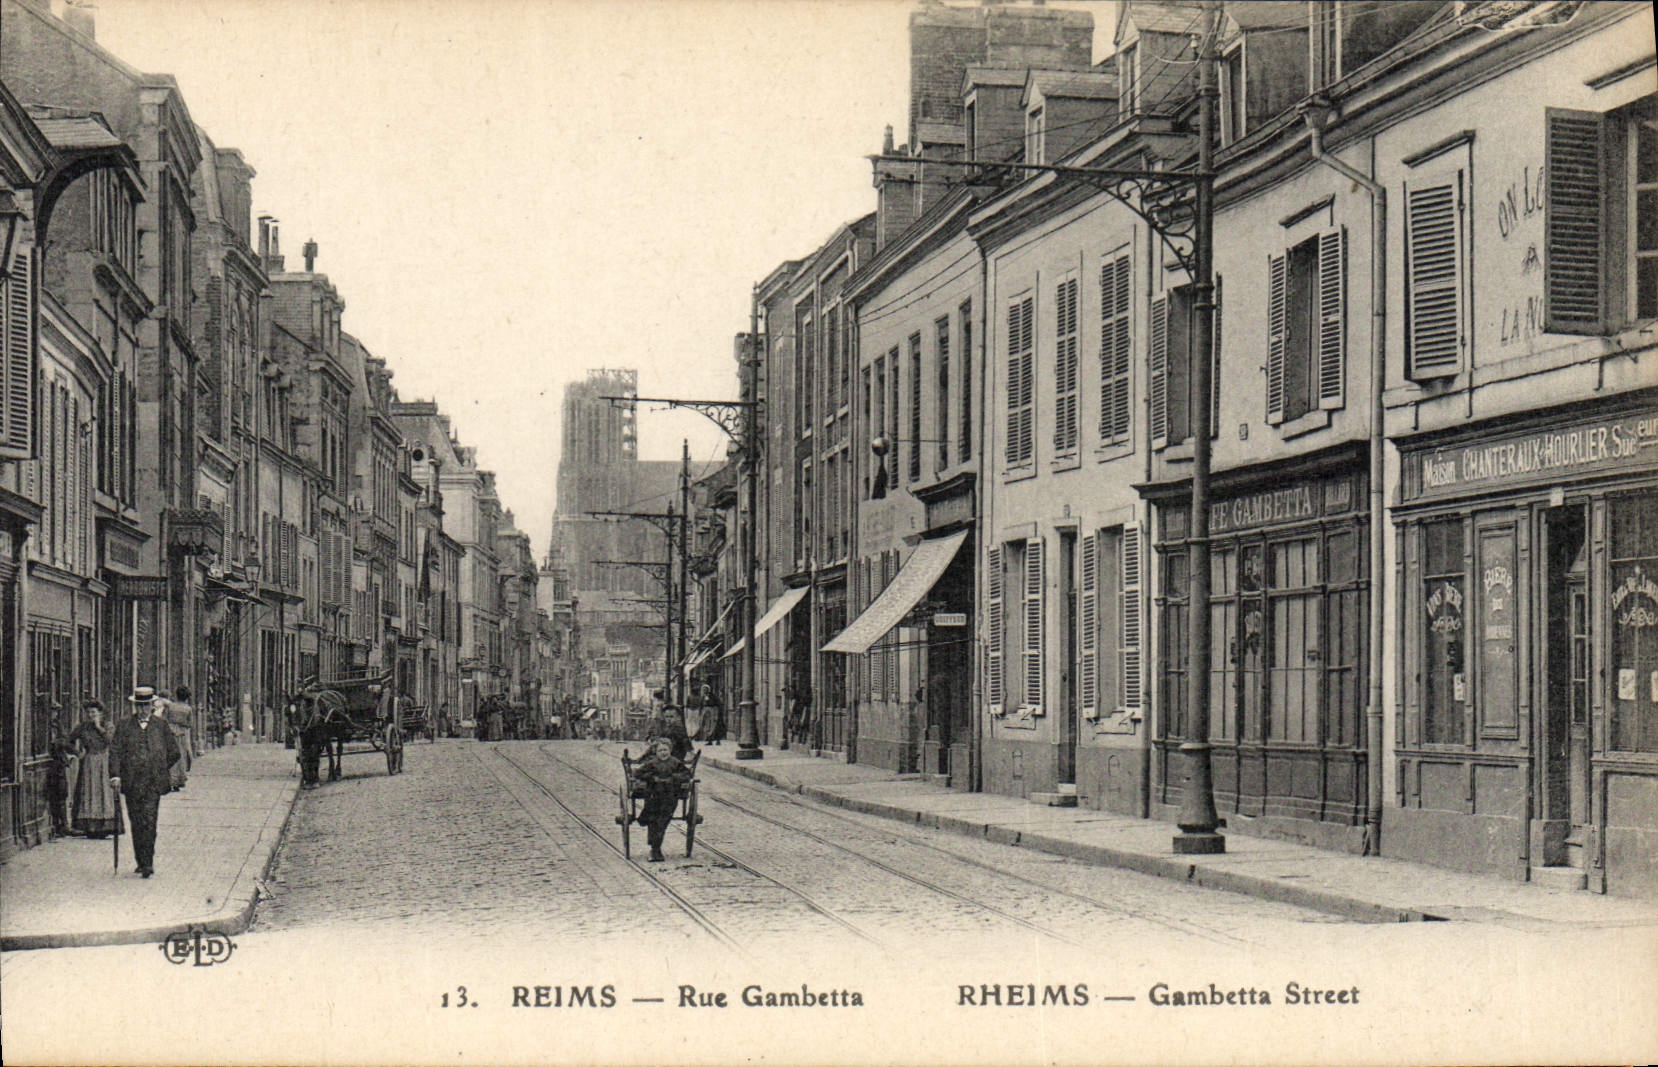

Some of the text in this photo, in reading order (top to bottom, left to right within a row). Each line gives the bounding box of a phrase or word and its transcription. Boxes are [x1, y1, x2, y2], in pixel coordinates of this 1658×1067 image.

[1498, 181, 1518, 239] ON
[1424, 453, 1456, 488] Maison
[1232, 486, 1313, 527] GAMBETTA
